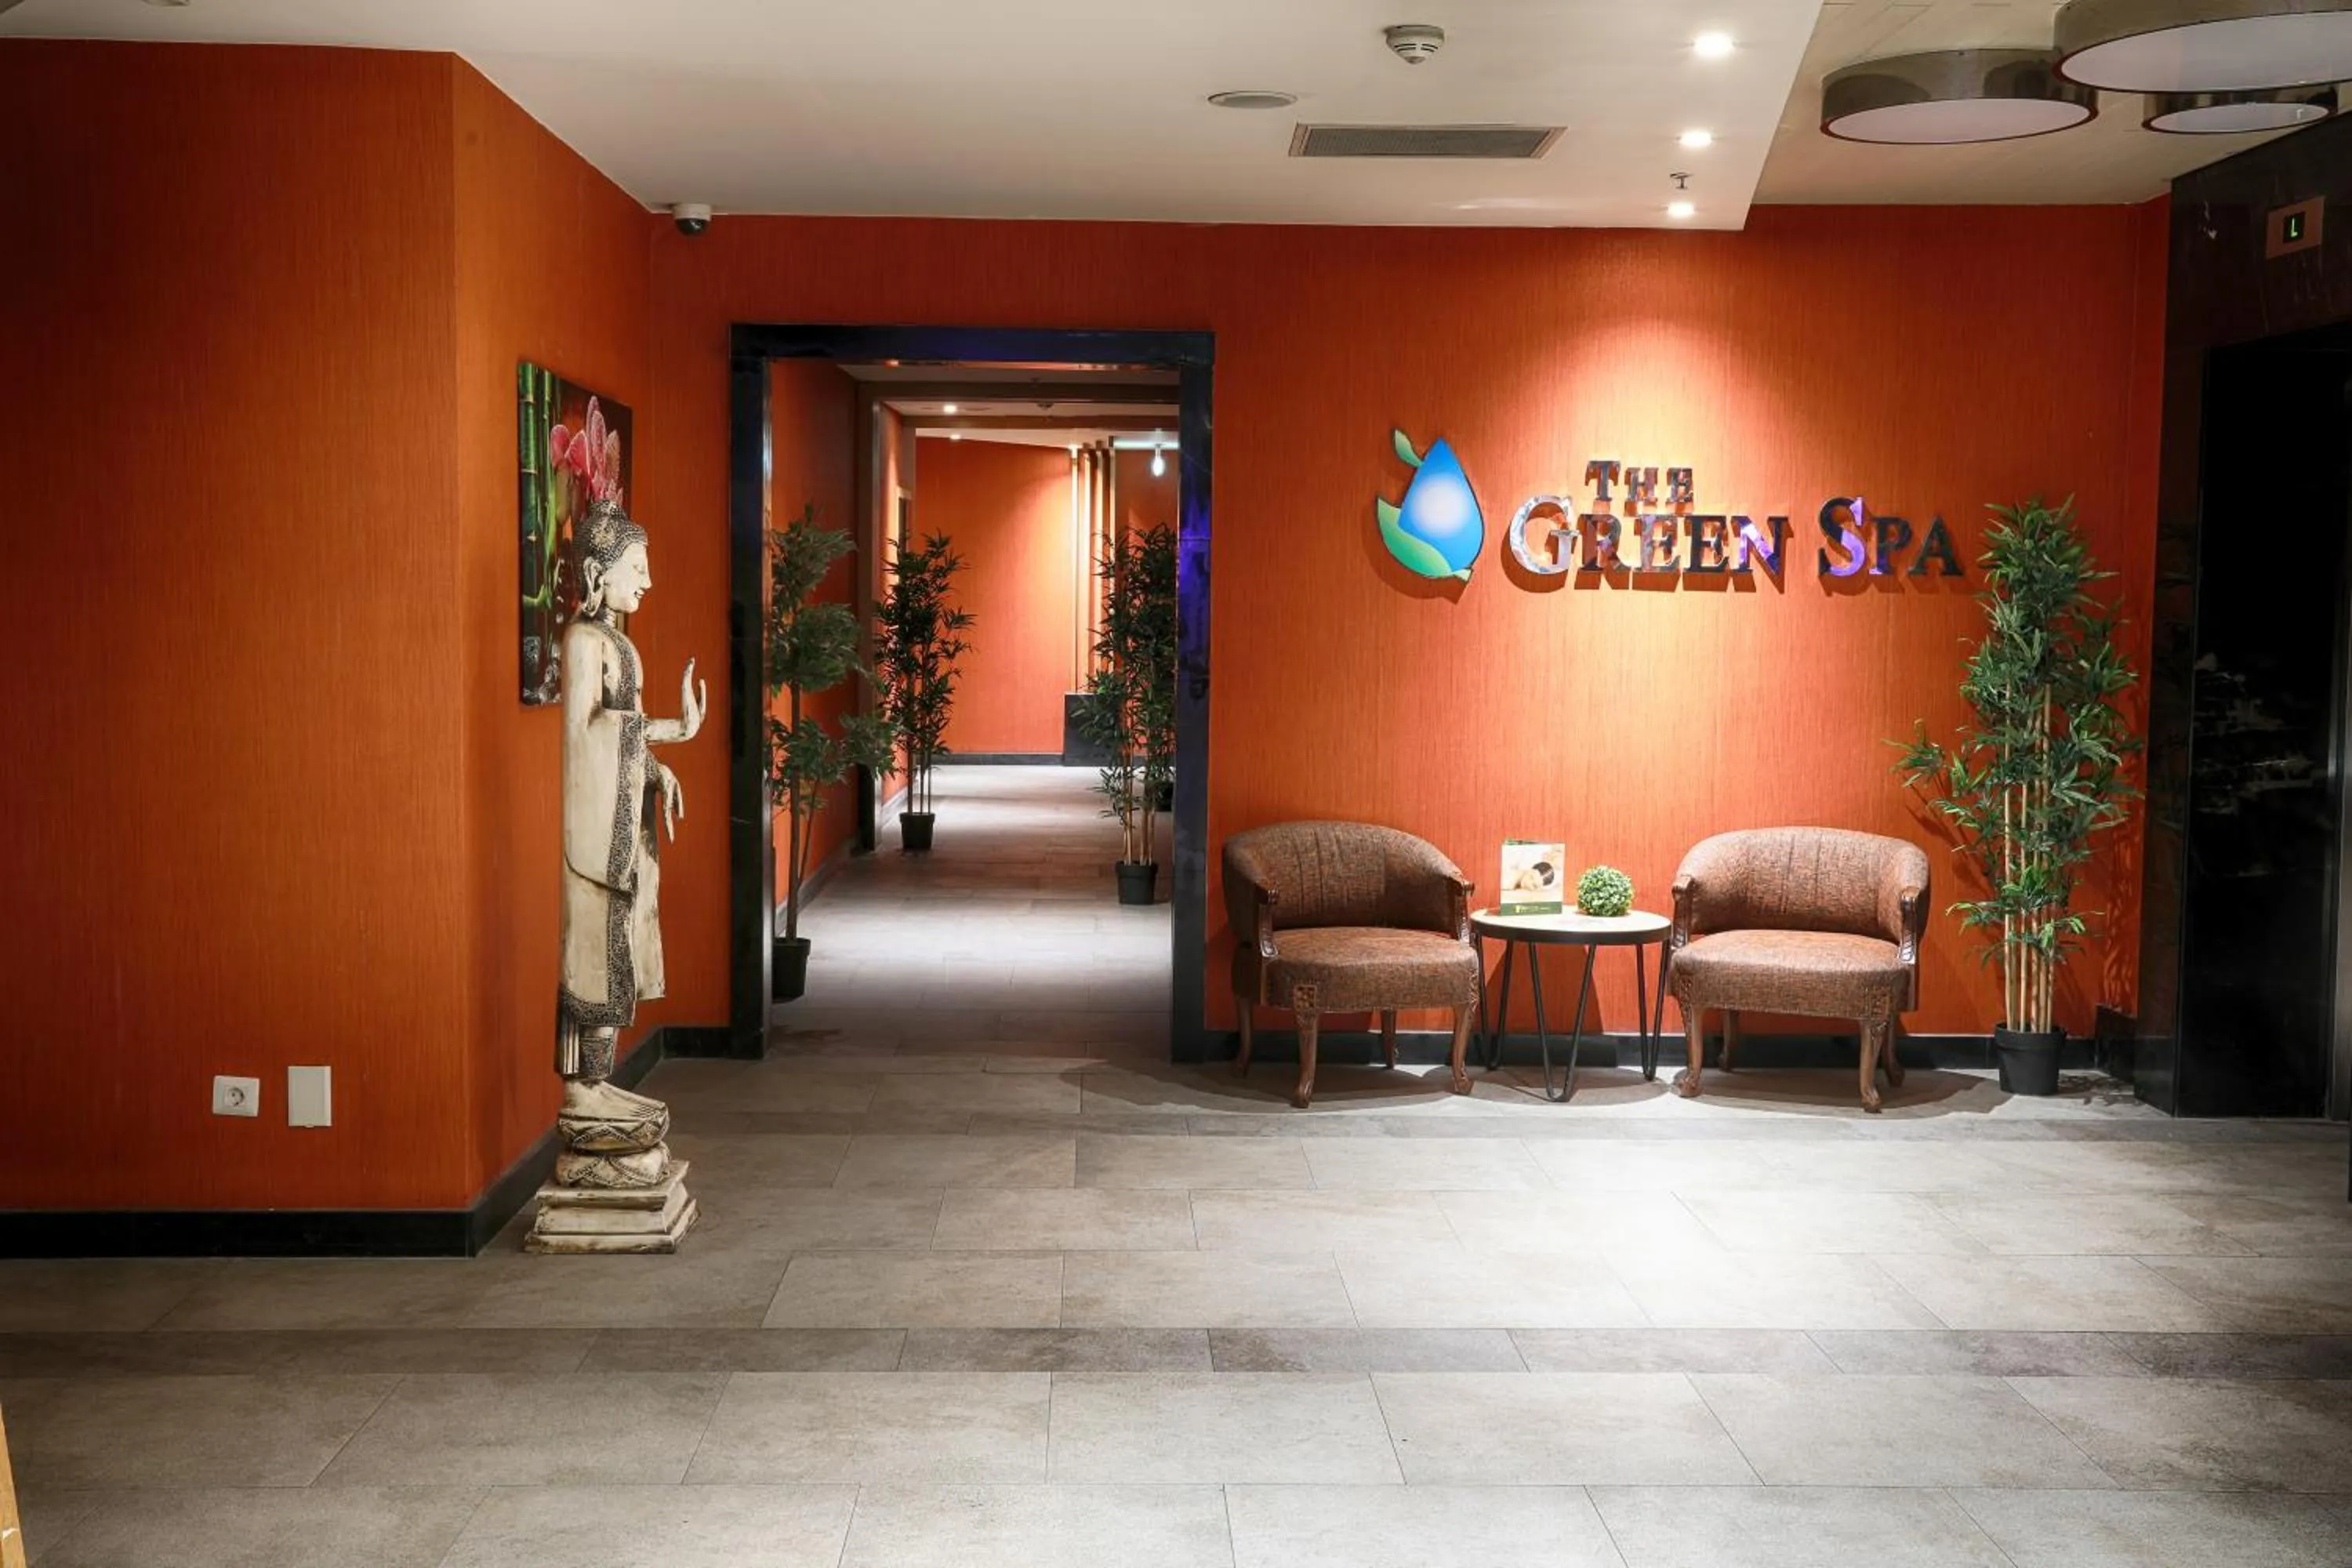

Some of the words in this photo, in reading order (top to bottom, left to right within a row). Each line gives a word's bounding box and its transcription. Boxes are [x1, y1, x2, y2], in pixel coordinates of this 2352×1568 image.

[1585, 460, 1694, 502] THE
[1509, 495, 1791, 575] GREEN
[1818, 496, 1964, 576] SPA
